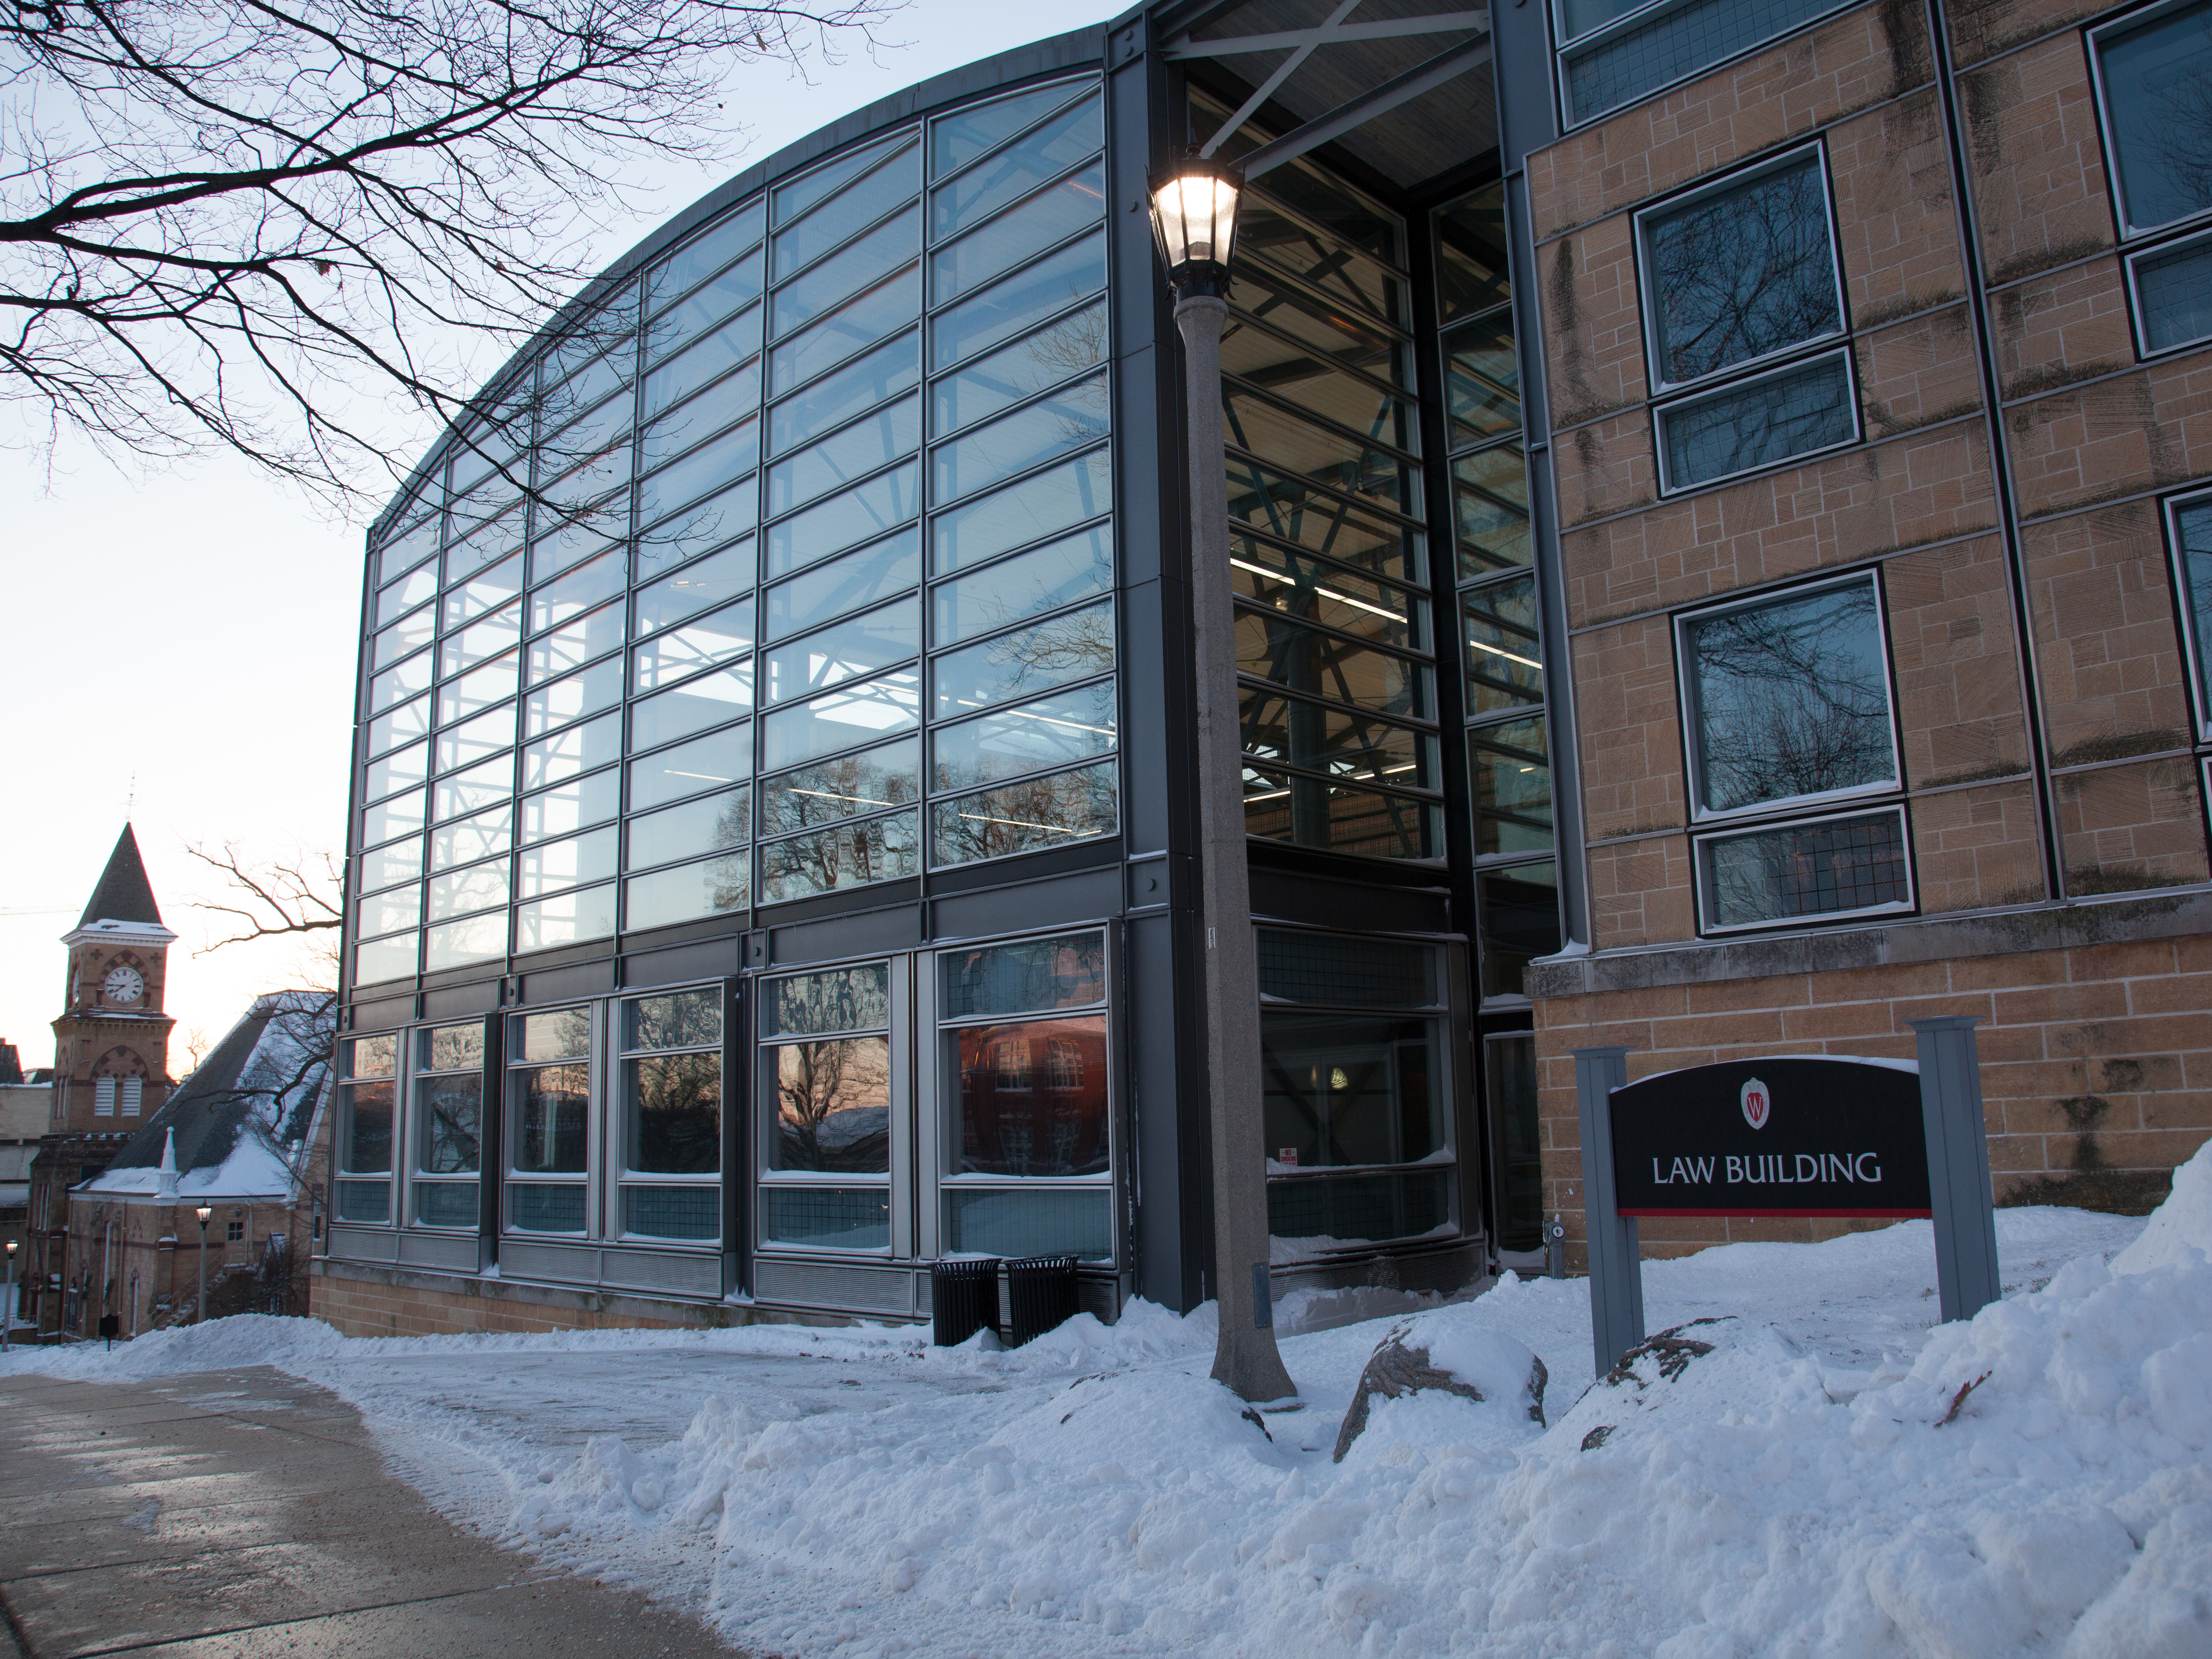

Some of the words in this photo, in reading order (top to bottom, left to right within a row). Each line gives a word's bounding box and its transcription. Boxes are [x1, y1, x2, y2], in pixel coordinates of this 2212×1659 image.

[1747, 1095, 1762, 1118] W
[1652, 1156, 1715, 1184] LAW
[1725, 1152, 1882, 1184] BUILDING
